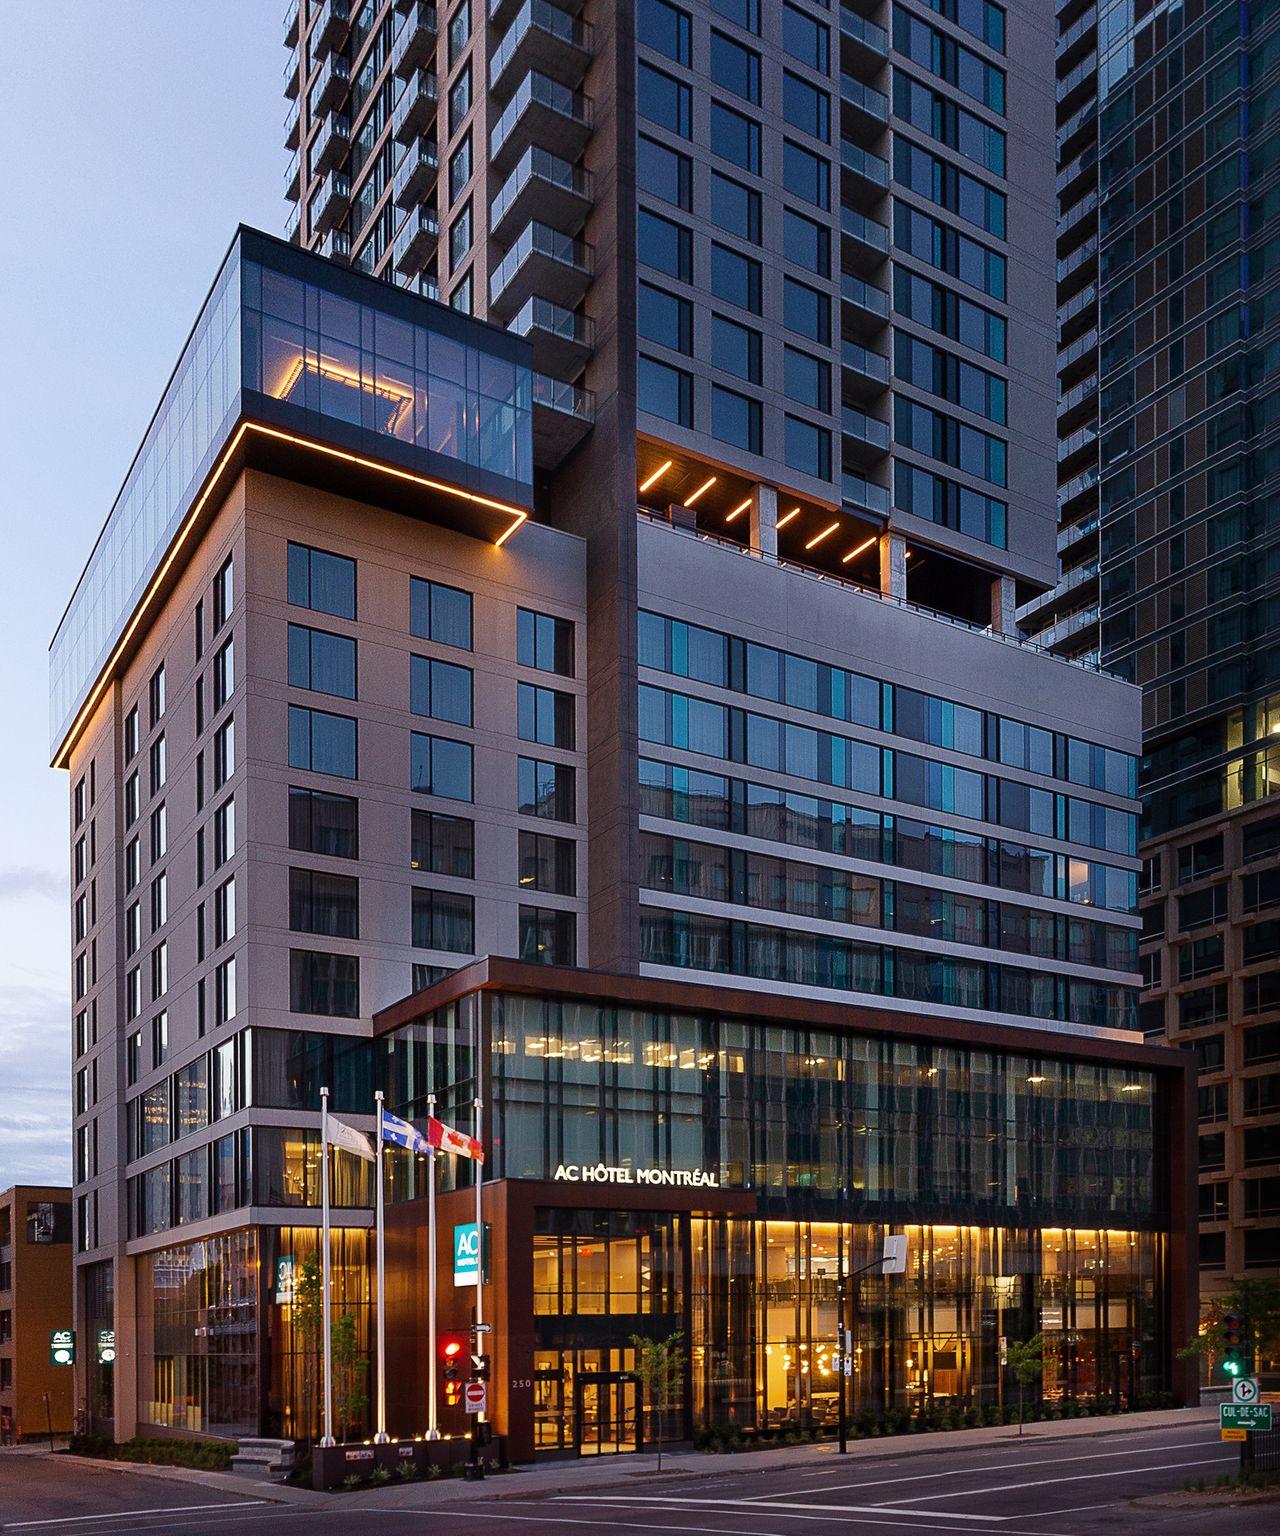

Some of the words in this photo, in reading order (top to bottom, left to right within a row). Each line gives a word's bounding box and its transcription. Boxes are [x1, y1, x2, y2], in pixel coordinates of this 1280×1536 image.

[553, 1164, 580, 1182] AC
[582, 1162, 634, 1184] HÔTEL
[636, 1167, 720, 1188] MONTRÉAL
[457, 1230, 479, 1257] AC
[53, 1331, 71, 1340] AC
[512, 1379, 531, 1389] 250
[1222, 1406, 1269, 1418] CUL-DE-SAC
